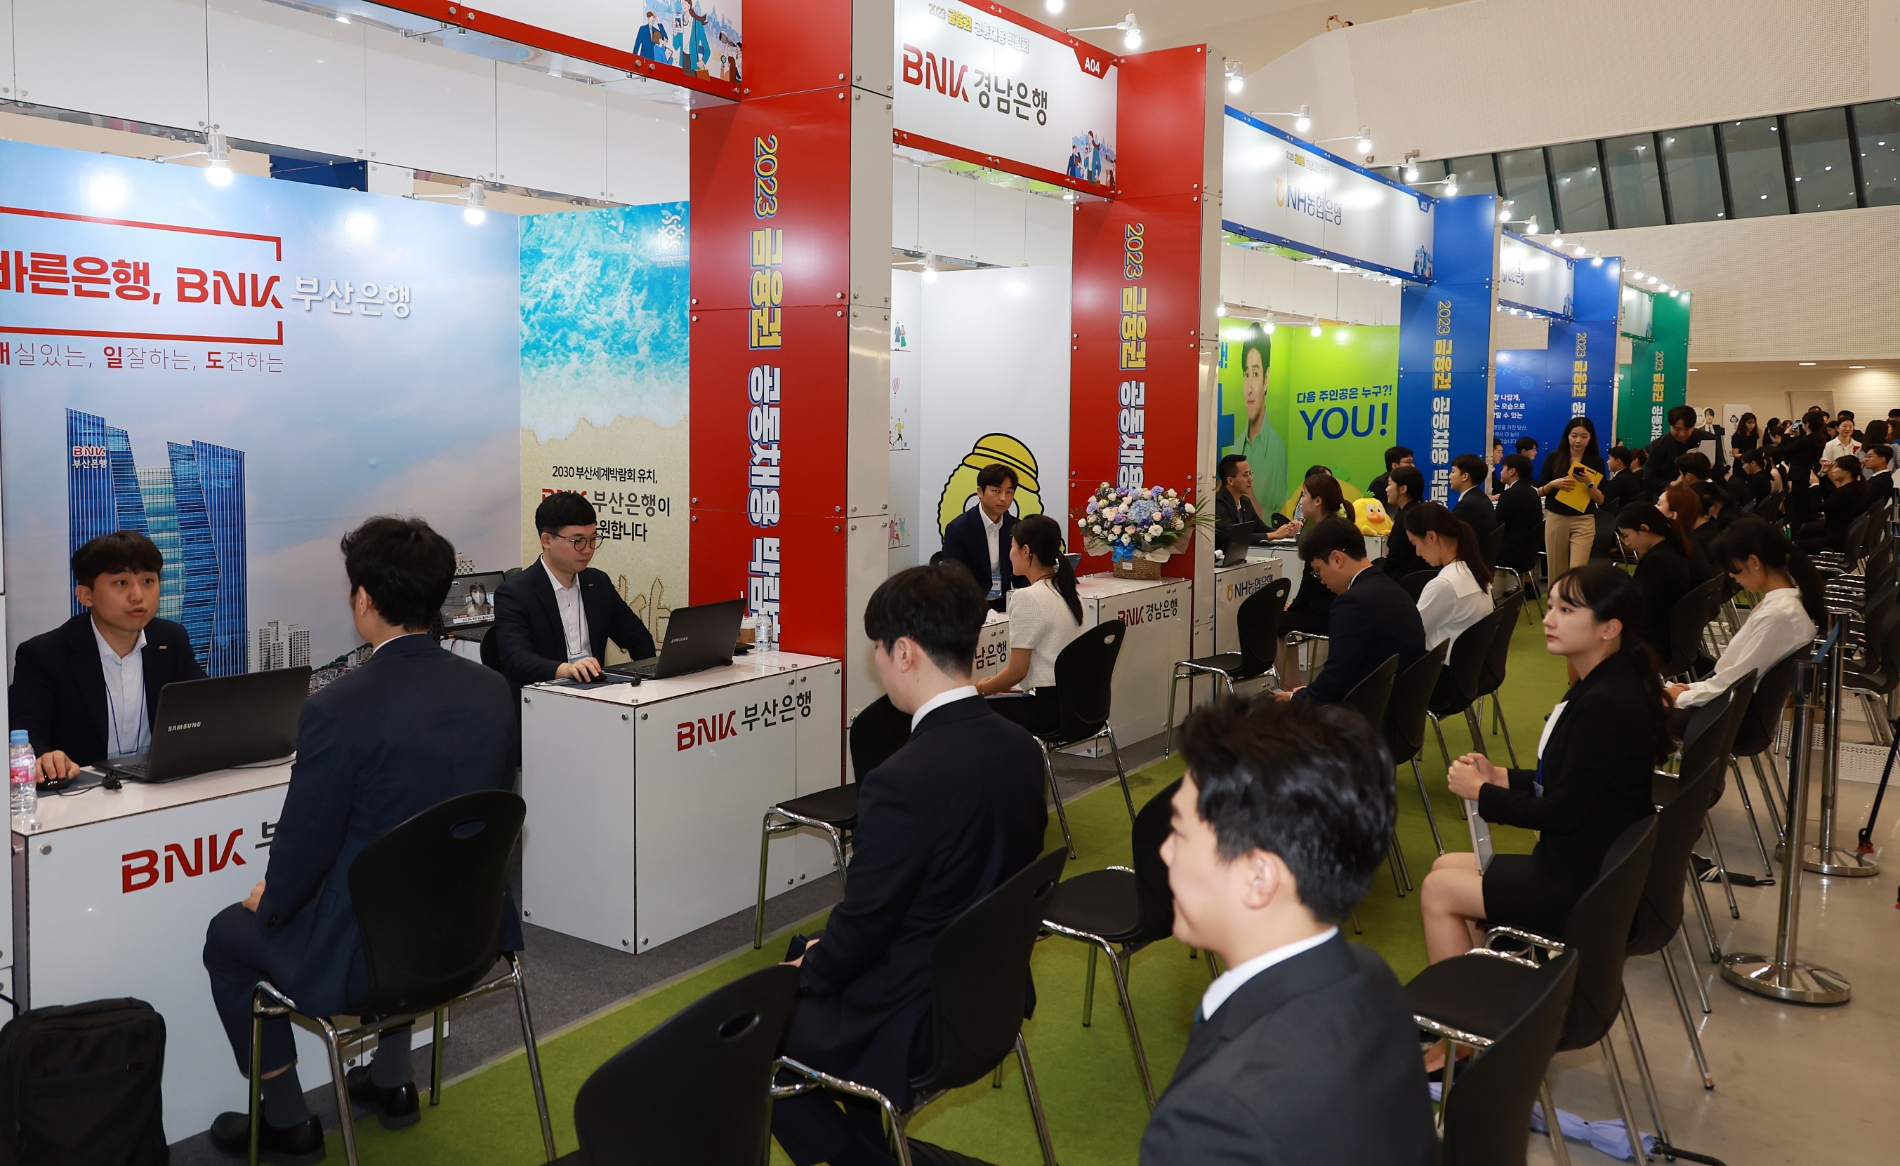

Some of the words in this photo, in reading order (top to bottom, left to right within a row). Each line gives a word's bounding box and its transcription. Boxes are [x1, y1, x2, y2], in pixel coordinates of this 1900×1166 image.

[1084, 56, 1101, 75] A04
[902, 43, 969, 103] BNK
[974, 68, 1048, 126] 경남은행
[754, 134, 779, 219] 2023
[1287, 184, 1342, 226] NH농협은행
[1124, 222, 1145, 280] 2023
[177, 267, 284, 309] BNK
[291, 276, 411, 318] 부산은행
[749, 228, 783, 350] 금융권
[1119, 285, 1147, 370] 금융권
[1437, 300, 1452, 335] 2023
[103, 346, 196, 371] 일잘하는,
[205, 351, 283, 373] 도전하는
[1576, 332, 1587, 358] 2023
[1433, 338, 1452, 390] 금융권
[1572, 360, 1588, 397] 금융권
[1297, 392, 1316, 404] 다음
[1319, 387, 1358, 402] 주인공은
[1362, 384, 1393, 398] 누구?!
[1299, 403, 1389, 440] YOU!
[1431, 396, 1450, 465] 공동채용
[72, 459, 107, 468] 부산은행
[73, 446, 106, 457] BNK
[748, 365, 781, 527] 공동채용
[552, 466, 575, 477] 2030
[576, 466, 636, 482] 부산세계박람회
[637, 469, 658, 484] 유치,
[1431, 469, 1449, 508] 박람
[596, 520, 647, 542] 원합니다
[1118, 606, 1144, 627] BNK
[1146, 598, 1178, 622] 경남은행
[975, 640, 1007, 669] 남은행
[168, 721, 201, 732] SAMSUNG
[677, 710, 737, 752] BNK
[741, 690, 812, 732] 부산은행
[121, 828, 247, 894] BNK
